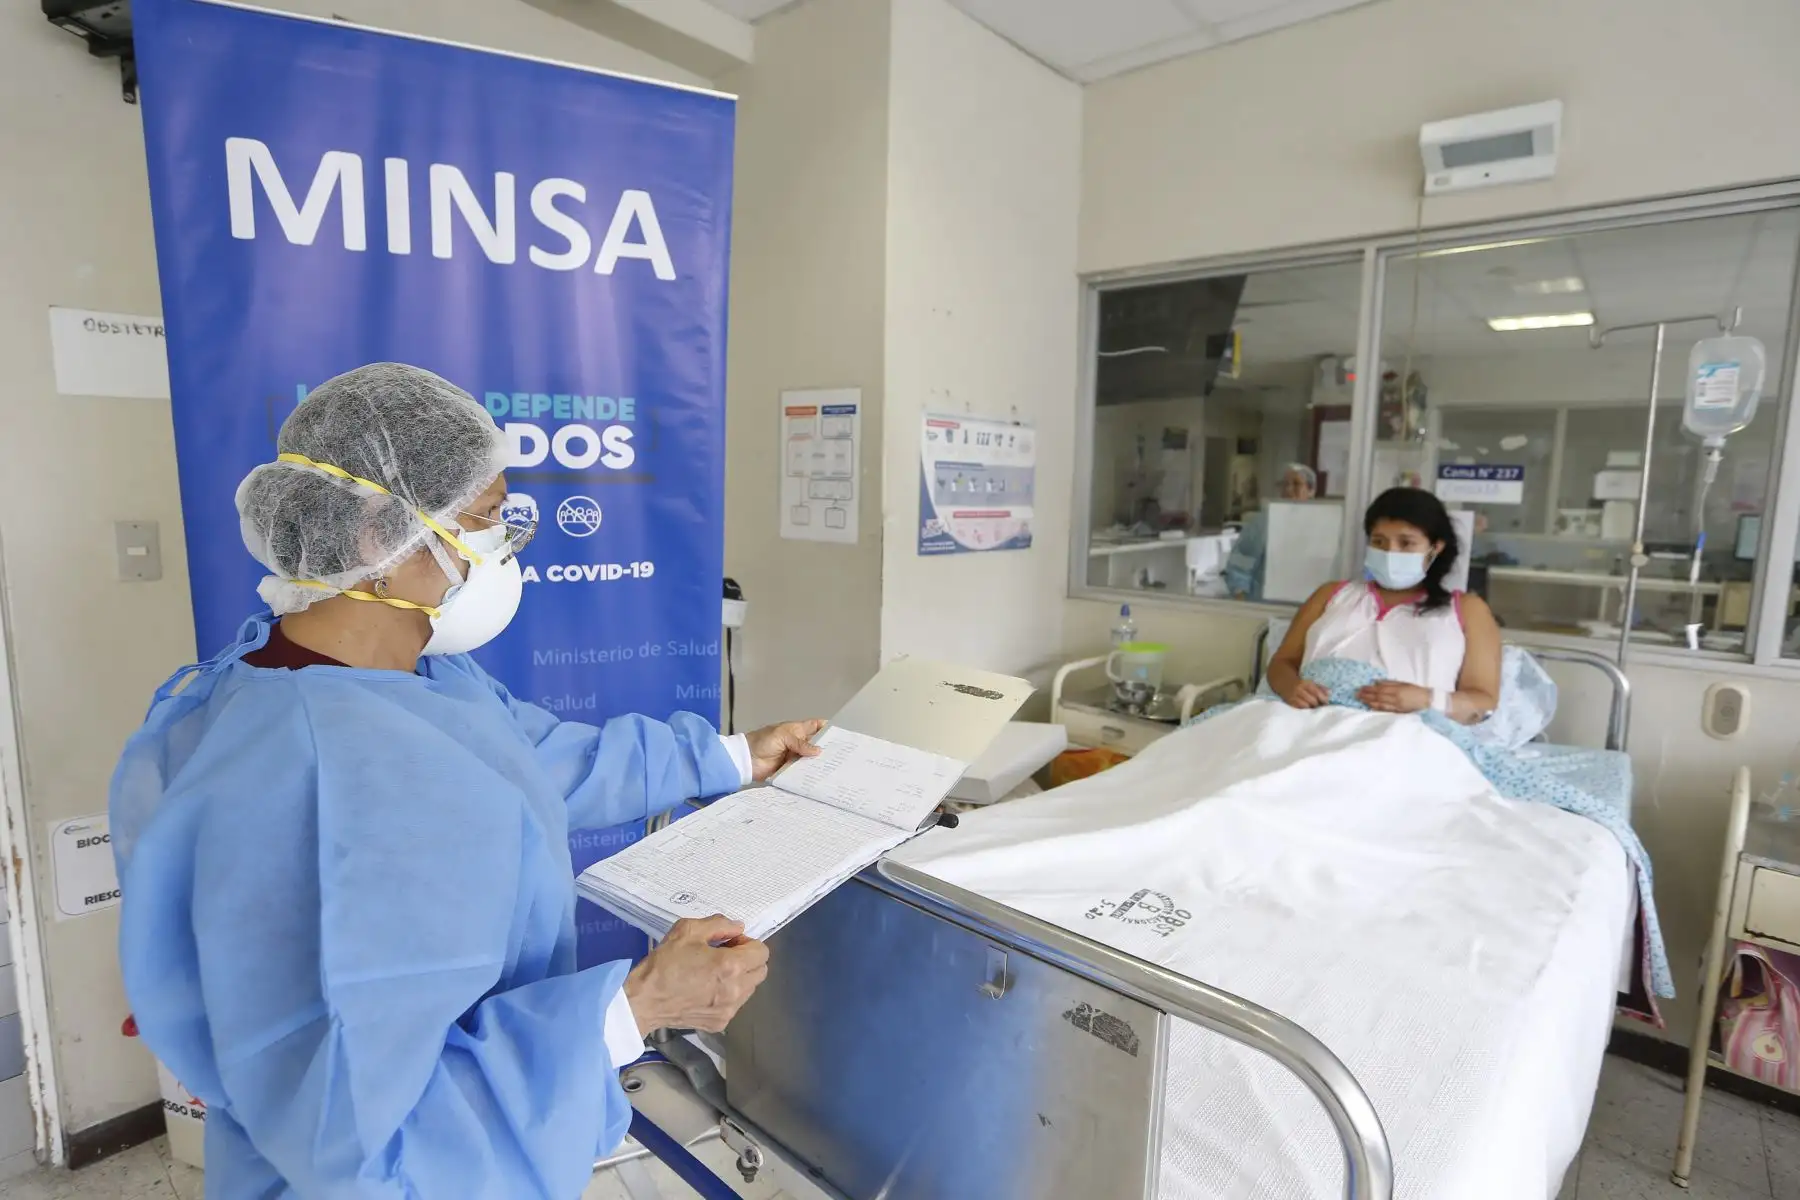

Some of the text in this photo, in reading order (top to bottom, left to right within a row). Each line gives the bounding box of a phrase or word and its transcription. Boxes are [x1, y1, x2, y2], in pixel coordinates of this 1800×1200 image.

[225, 137, 676, 281] MINSA
[485, 391, 636, 421] DEPENDE
[1442, 466, 1476, 478] Cama
[1496, 468, 1520, 479] 237
[546, 561, 655, 583] COVID-19
[533, 639, 719, 666] Ministerio de Salud
[541, 692, 596, 712] Salud
